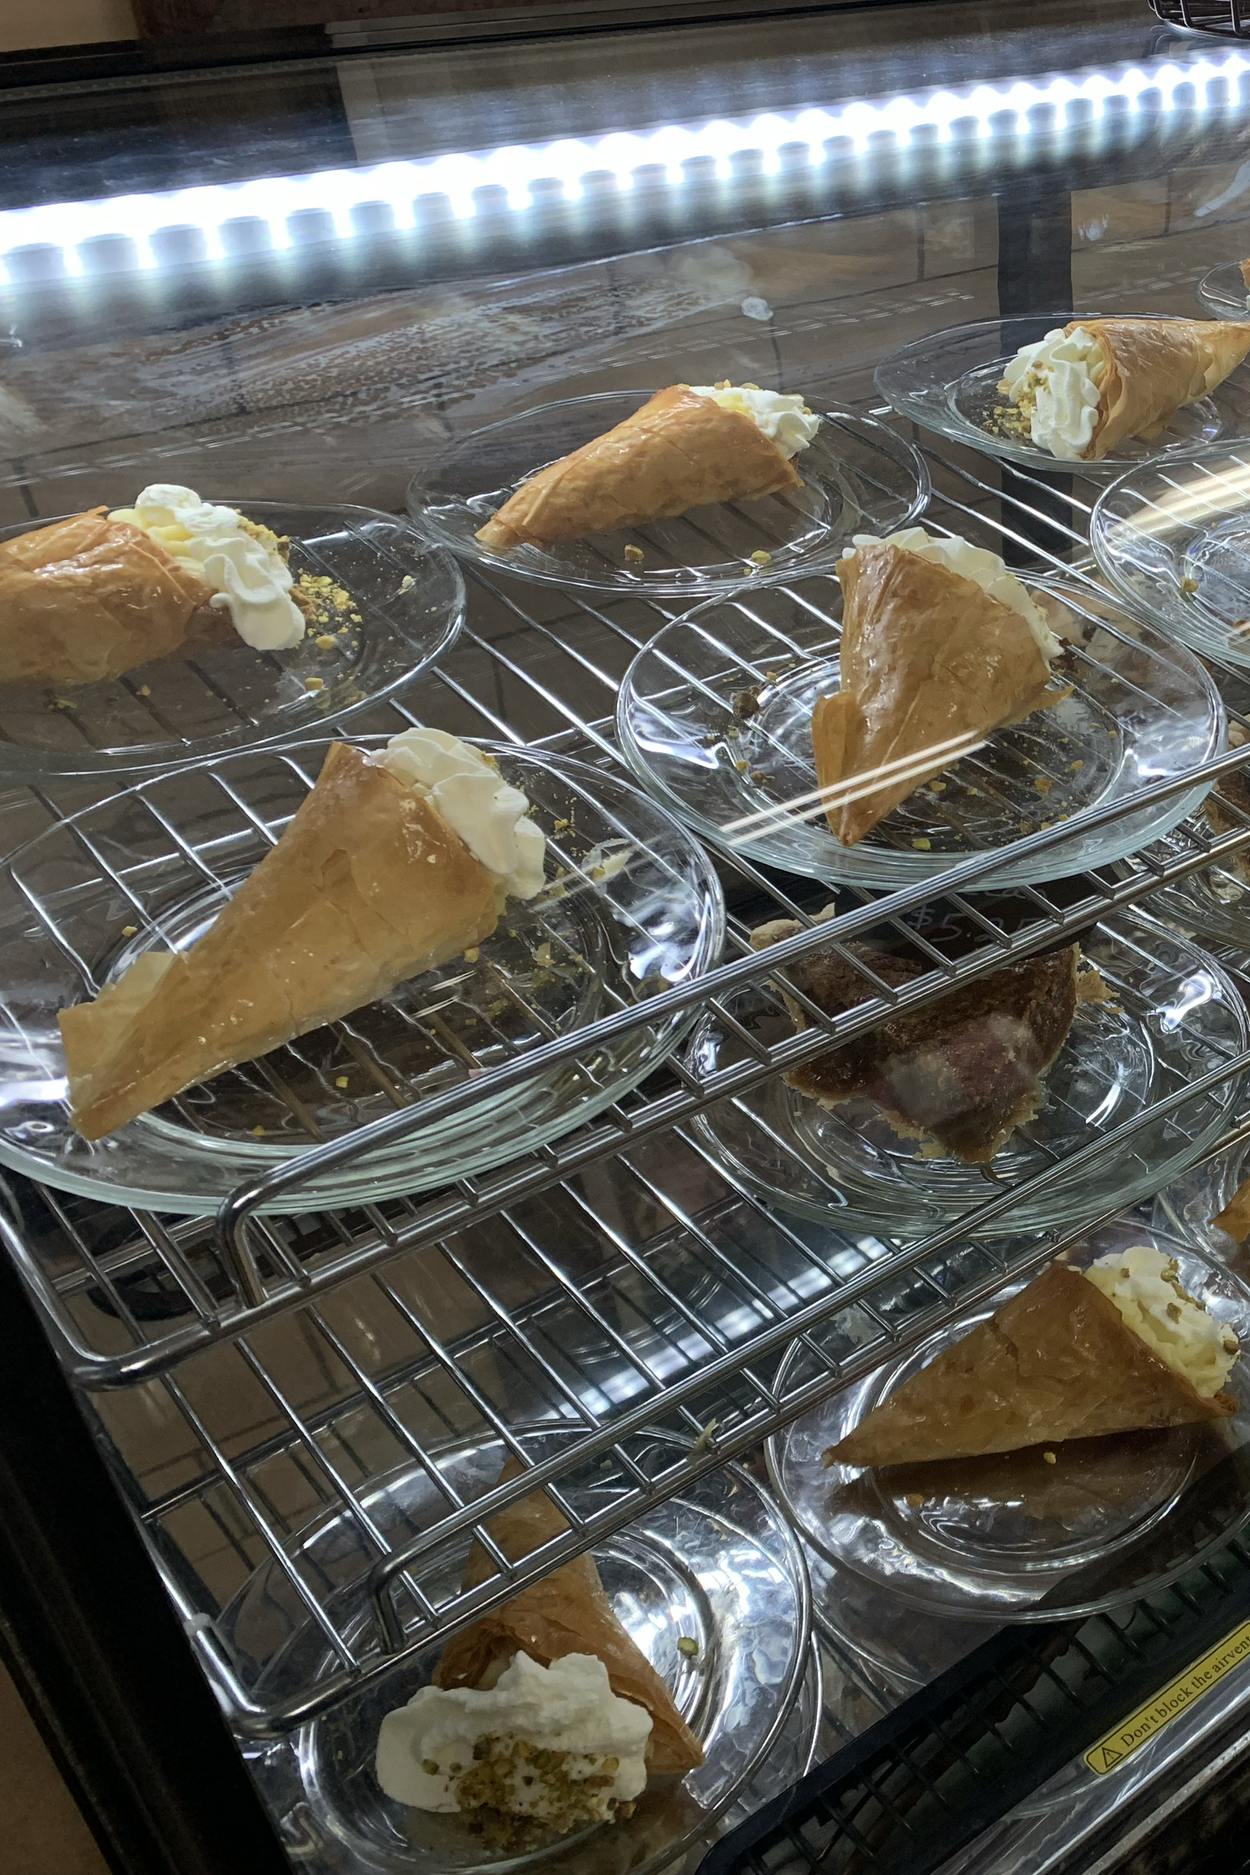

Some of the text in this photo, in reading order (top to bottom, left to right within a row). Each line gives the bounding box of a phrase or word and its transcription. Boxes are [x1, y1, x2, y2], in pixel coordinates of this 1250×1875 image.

[1120, 1713, 1159, 1747] Don't
[1157, 1688, 1193, 1718] block
[1191, 1671, 1212, 1689] the
